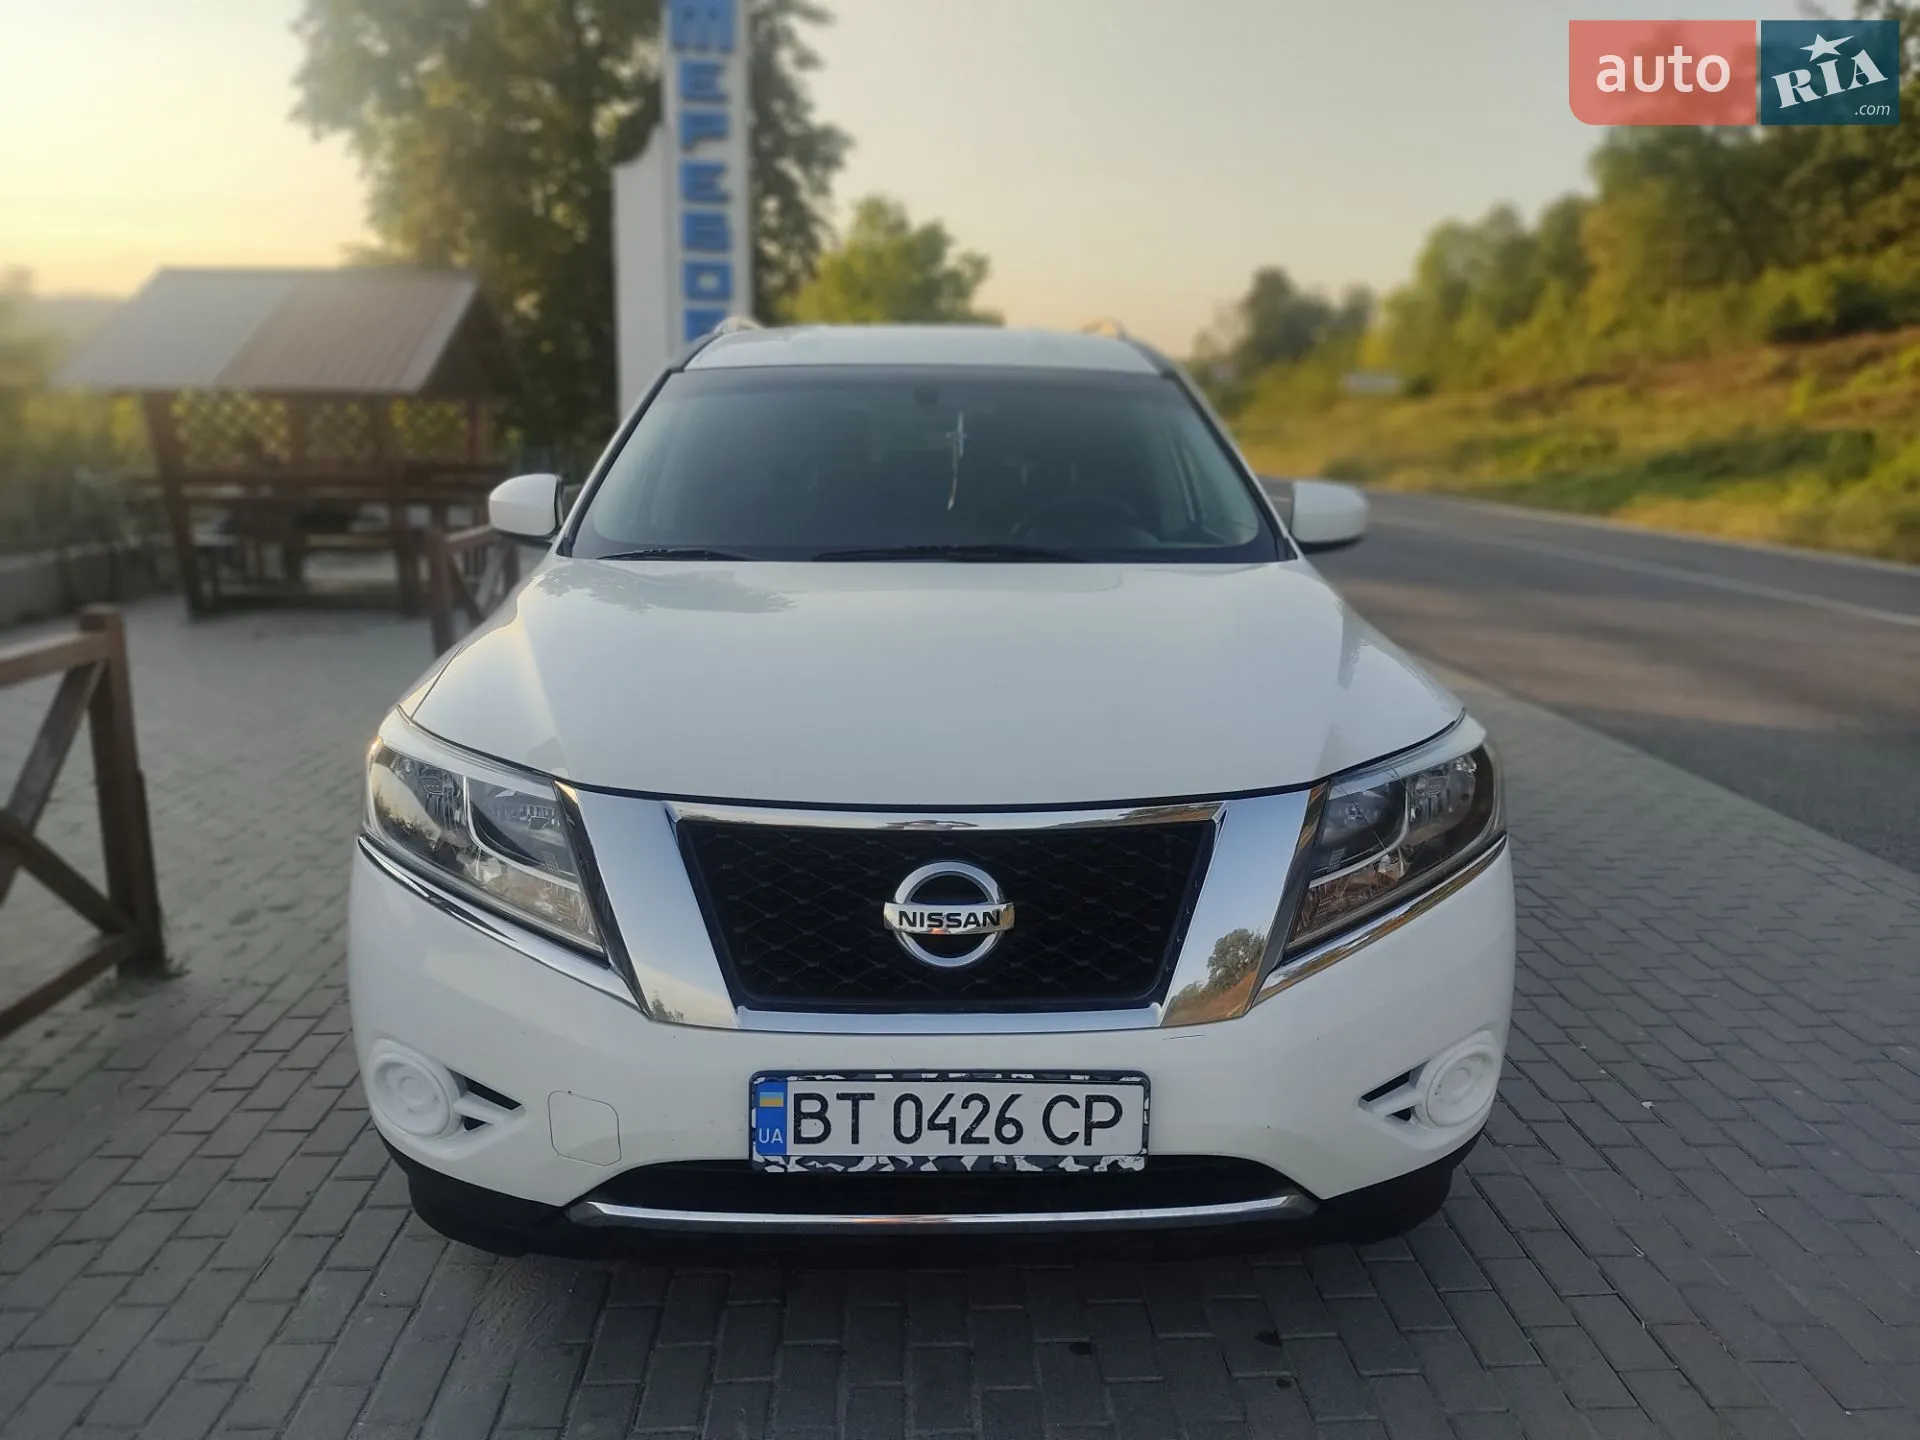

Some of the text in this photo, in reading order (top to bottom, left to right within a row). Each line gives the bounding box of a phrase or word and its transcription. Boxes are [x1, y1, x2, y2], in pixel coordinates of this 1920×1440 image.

[898, 910, 1001, 929] NISSAN
[793, 1092, 1123, 1146] BT 0426 CP
[758, 1127, 784, 1145] UA
